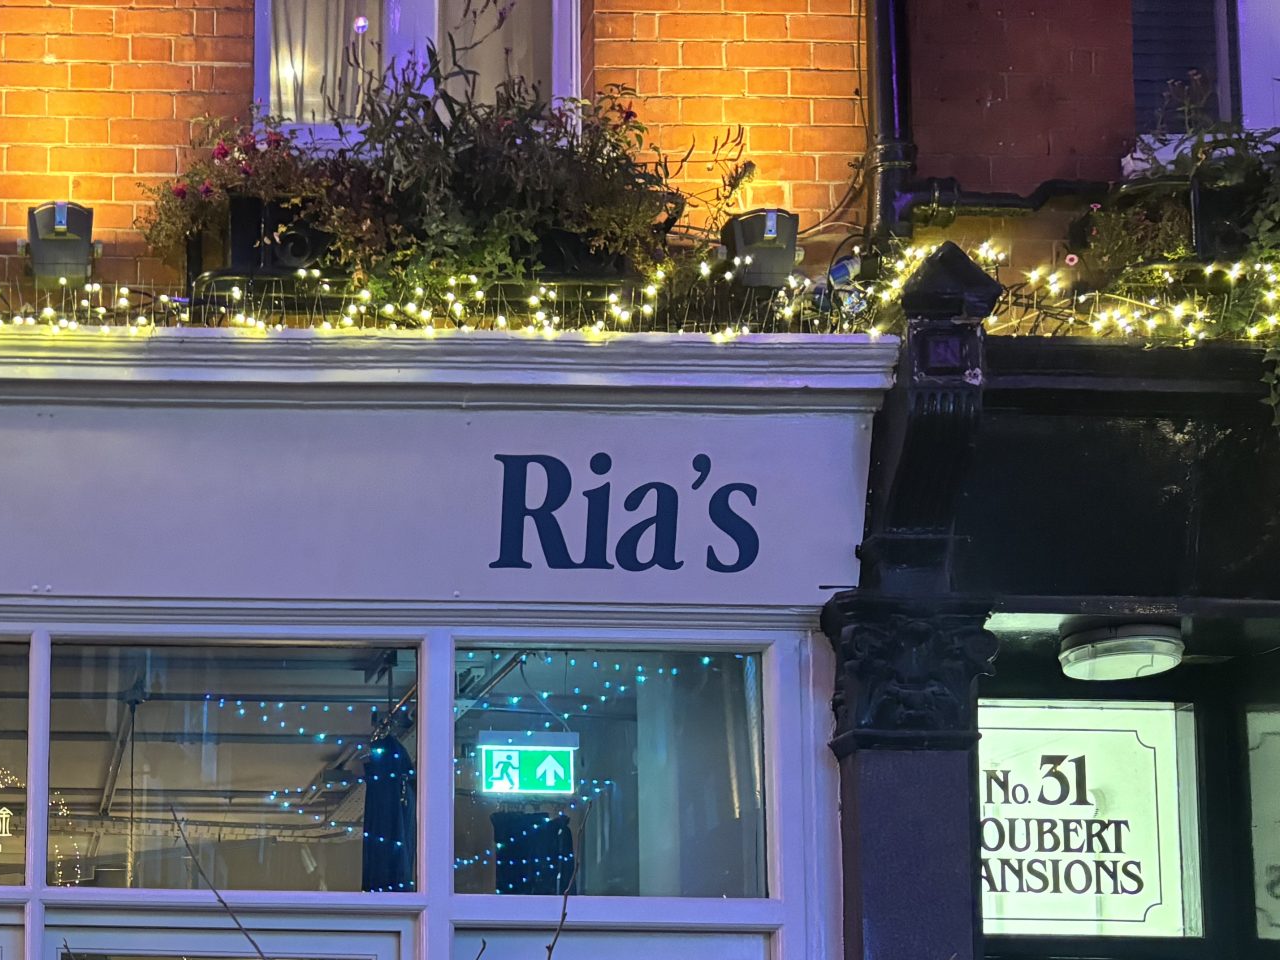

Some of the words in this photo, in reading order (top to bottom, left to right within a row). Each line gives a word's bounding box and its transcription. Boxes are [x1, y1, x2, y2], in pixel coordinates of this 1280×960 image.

[488, 452, 760, 574] Ria's
[982, 769, 1032, 805] No.
[1037, 754, 1095, 806] 31
[980, 817, 1132, 854] OUBERT
[981, 857, 1145, 895] ANSIONS
